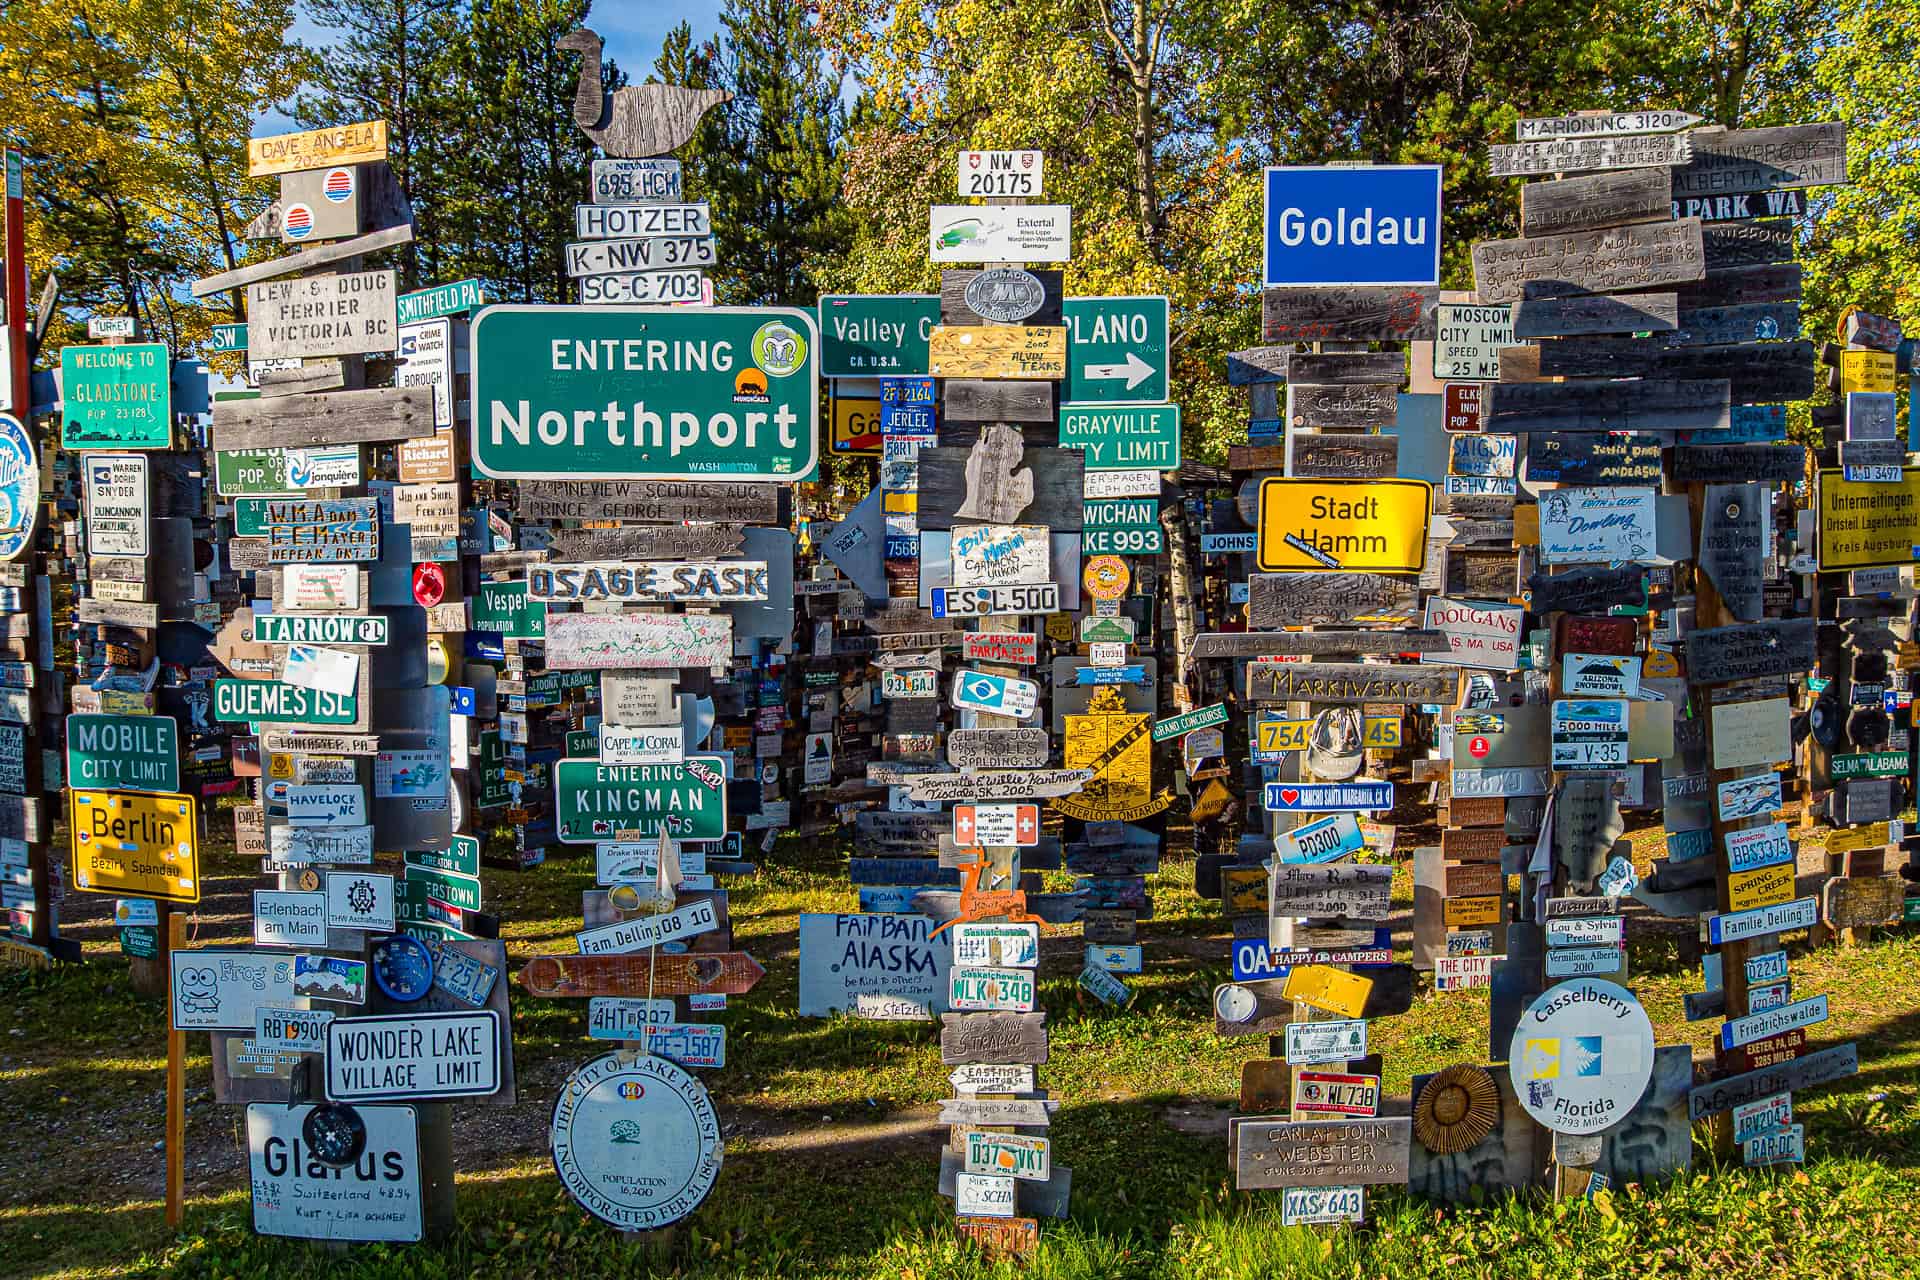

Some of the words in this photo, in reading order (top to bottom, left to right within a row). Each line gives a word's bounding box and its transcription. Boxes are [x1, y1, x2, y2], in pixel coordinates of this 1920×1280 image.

[1635, 114, 1671, 129] 3120
[261, 138, 298, 158] DAVE
[313, 127, 374, 149] ANGELA
[615, 162, 657, 171] NEVADA
[990, 154, 1013, 170] NW
[970, 173, 1032, 194] 20175
[1686, 195, 1750, 220] PARK
[1766, 192, 1800, 214] WA
[587, 208, 700, 233] HOTZER
[1016, 217, 1055, 228] Extertal
[1279, 207, 1426, 246] Goldau
[573, 244, 650, 272] K-NW
[664, 240, 711, 263] 375
[257, 284, 293, 302] LEW
[339, 274, 387, 295] DOUG
[656, 275, 700, 298] 703
[280, 301, 360, 321] FERRIER
[399, 289, 459, 320] SMITHFIELD
[460, 284, 477, 305] PA
[1453, 309, 1510, 323] MOSCOW
[214, 329, 236, 348] SW
[268, 321, 353, 342] VICTORIA
[365, 319, 388, 335] BC
[419, 328, 441, 339] CRIME
[833, 316, 905, 347] Valley
[1441, 329, 1469, 342] CITY
[419, 339, 443, 352] WATCH
[1448, 342, 1478, 357] SPEED
[75, 352, 134, 368] WELCOME
[140, 352, 154, 366] TO
[551, 339, 734, 372] ENTERING
[1452, 363, 1470, 376] 25
[404, 371, 442, 387] BOROUGH
[76, 384, 157, 402] GLADSTONE
[490, 400, 798, 458] Northport
[888, 413, 928, 427] JERLEE
[1066, 414, 1161, 435] GRAYVILLE
[1117, 441, 1170, 461] LIMIT
[1453, 439, 1515, 457] SAIGON
[112, 464, 141, 473] WARREN
[238, 469, 266, 483] POP.
[310, 469, 358, 486] jonquière
[1875, 465, 1899, 479] 3497
[98, 486, 134, 497] SNYDER
[1831, 491, 1913, 510] Untermeitingen
[529, 503, 586, 517] PRINCE
[602, 503, 667, 518] GEORGE
[1311, 496, 1379, 520] Stadt
[1826, 516, 1859, 529] Ortsteil
[1113, 531, 1160, 551] 993
[1301, 529, 1386, 553] Hamm
[1832, 541, 1859, 553] Kreis
[1862, 537, 1913, 555] Augsburg
[529, 567, 657, 598] OSAGE
[673, 567, 768, 597] SASK
[485, 590, 528, 616] Vesper
[261, 618, 356, 641] TARNOW
[362, 622, 381, 638] PL
[477, 621, 514, 632] POPULATION
[531, 621, 542, 632] 541
[1432, 608, 1518, 633] DOUGANS
[1467, 639, 1484, 648] MA
[1492, 640, 1514, 652] USA
[561, 674, 593, 689] ALABAMA
[1575, 682, 1623, 690] SNOWBOWL
[218, 684, 307, 716] GUEMES
[1155, 722, 1179, 737] GRAND
[1182, 708, 1225, 728] CONCOURSE
[79, 725, 169, 754] MOBILE
[604, 736, 631, 750] CAPE
[645, 735, 681, 749] CORAL
[1010, 730, 1039, 741] JOY
[353, 740, 368, 751] PA
[1585, 744, 1620, 762] V-35
[82, 760, 123, 778] CITY
[131, 761, 168, 780] LIMIT
[1832, 760, 1859, 773] SELMA
[1865, 756, 1909, 770] ALABAMA
[596, 766, 684, 782] ENTERING
[290, 794, 356, 805] HAVELOCK
[1003, 785, 1034, 797] 2005
[576, 789, 703, 812] KINGMAN
[1119, 795, 1170, 821] ONTARIO
[339, 806, 355, 816] NC
[92, 808, 175, 844] Berlin
[458, 842, 469, 856] ST
[1299, 827, 1341, 861] PD300
[91, 856, 126, 872] Bezirk
[132, 860, 180, 877] Spandau
[1734, 872, 1773, 895] SPRING
[1758, 874, 1791, 896] CREEK
[260, 903, 323, 917] Erlenbach
[265, 926, 287, 934] am
[291, 922, 318, 935] Main
[1551, 922, 1570, 932] Lou
[1586, 920, 1617, 932] Sylvia
[1724, 915, 1763, 935] Familie
[1767, 909, 1801, 925] Delling
[583, 936, 616, 954] Fam.
[616, 924, 661, 946] Delling
[662, 916, 682, 934] 08
[691, 909, 712, 927] 10
[1275, 953, 1313, 965] HAPPY
[1332, 951, 1387, 962] CAMPERS
[1440, 960, 1458, 973] THE
[1463, 959, 1486, 972] CITY
[1574, 962, 1594, 972] 2010
[220, 959, 266, 990] Frog
[961, 970, 1024, 982] Saskatchewan
[953, 980, 986, 1000] WLK
[1535, 986, 1631, 1023] Casselberry
[1739, 1002, 1821, 1039] Friedrichswalde
[339, 1029, 423, 1062] WONDER
[432, 1026, 481, 1056] LAKE
[341, 1064, 416, 1090] VILLAGE
[436, 1061, 481, 1086] LIMIT
[572, 1068, 601, 1097] CITY
[633, 1057, 680, 1081] LAKE
[681, 1079, 716, 1143] FOREST
[1553, 1096, 1615, 1117] Florida
[1555, 1114, 1580, 1128] 3793
[1583, 1114, 1609, 1128] Miles
[1337, 1124, 1392, 1141] JOHN
[1277, 1144, 1376, 1162] WEBSTER
[558, 1143, 656, 1224] INCORPORATED
[602, 1174, 667, 1187] POPULATION
[293, 1184, 371, 1200] Switzerland
[1288, 1195, 1318, 1216] XAS
[1328, 1193, 1359, 1214] 643
